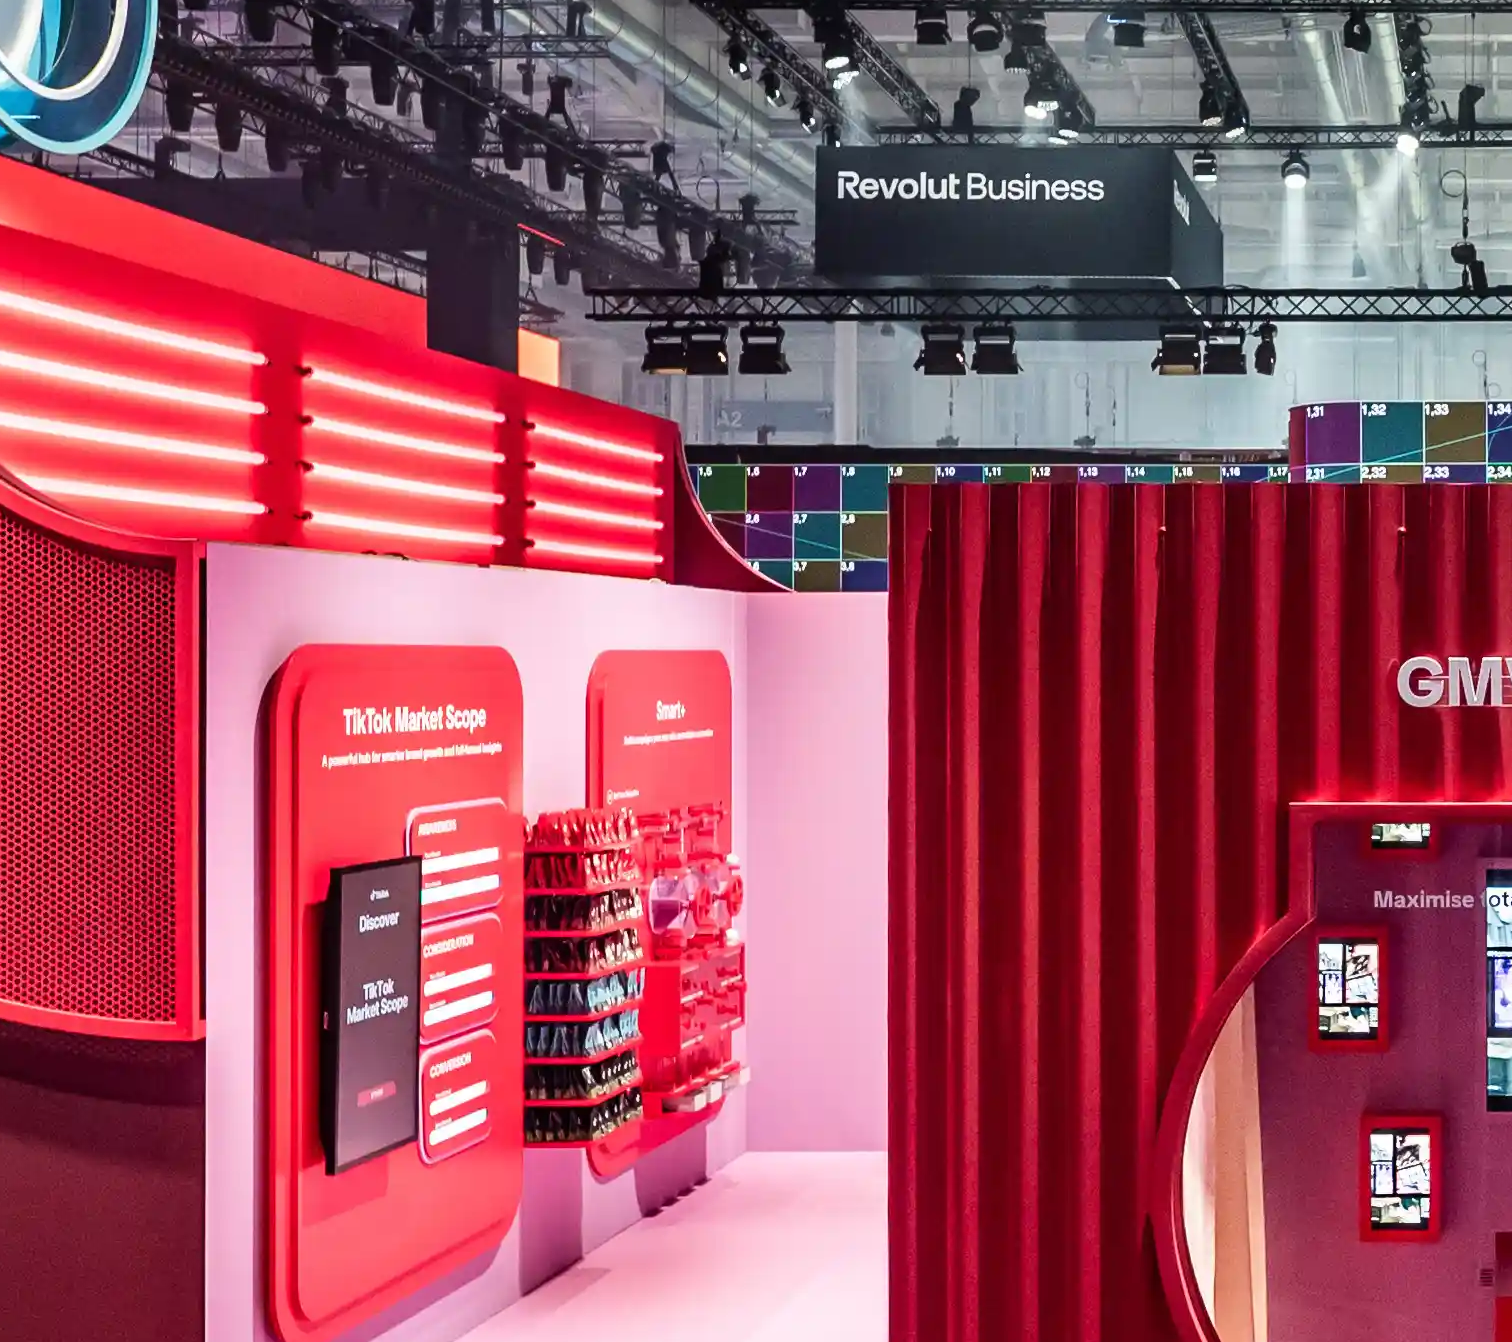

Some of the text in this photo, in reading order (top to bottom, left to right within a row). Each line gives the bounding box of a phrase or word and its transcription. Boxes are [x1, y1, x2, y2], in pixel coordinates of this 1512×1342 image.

[838, 171, 1105, 201] Revolut Business
[1306, 406, 1324, 419] 1,31
[1362, 404, 1387, 417] 1,32
[1424, 403, 1449, 418] 1,33
[1487, 403, 1512, 418] 1,34
[794, 466, 807, 477] 1,7
[889, 466, 903, 477] 1,9
[936, 466, 955, 477] 1,10
[984, 466, 1001, 477] 1,11
[1031, 466, 1050, 477] 1,12
[1079, 466, 1098, 477] 1,13
[1126, 466, 1145, 477] 1,14
[1174, 466, 1193, 477] 1,15
[1221, 466, 1240, 477] 1,16
[1269, 466, 1288, 477] 1,17
[1306, 467, 1325, 480] 2,31
[1361, 467, 1387, 480] 2,32
[1424, 466, 1449, 480] 2,33
[1487, 466, 1512, 480] 2,34
[656, 700, 686, 721] Smart+
[343, 704, 486, 735] TikTok Market Scope
[1374, 890, 1475, 908] Maximise
[359, 910, 401, 934] Discover
[362, 978, 395, 1001] TikTok
[346, 1001, 381, 1026] Market
[380, 994, 409, 1016] Scope
